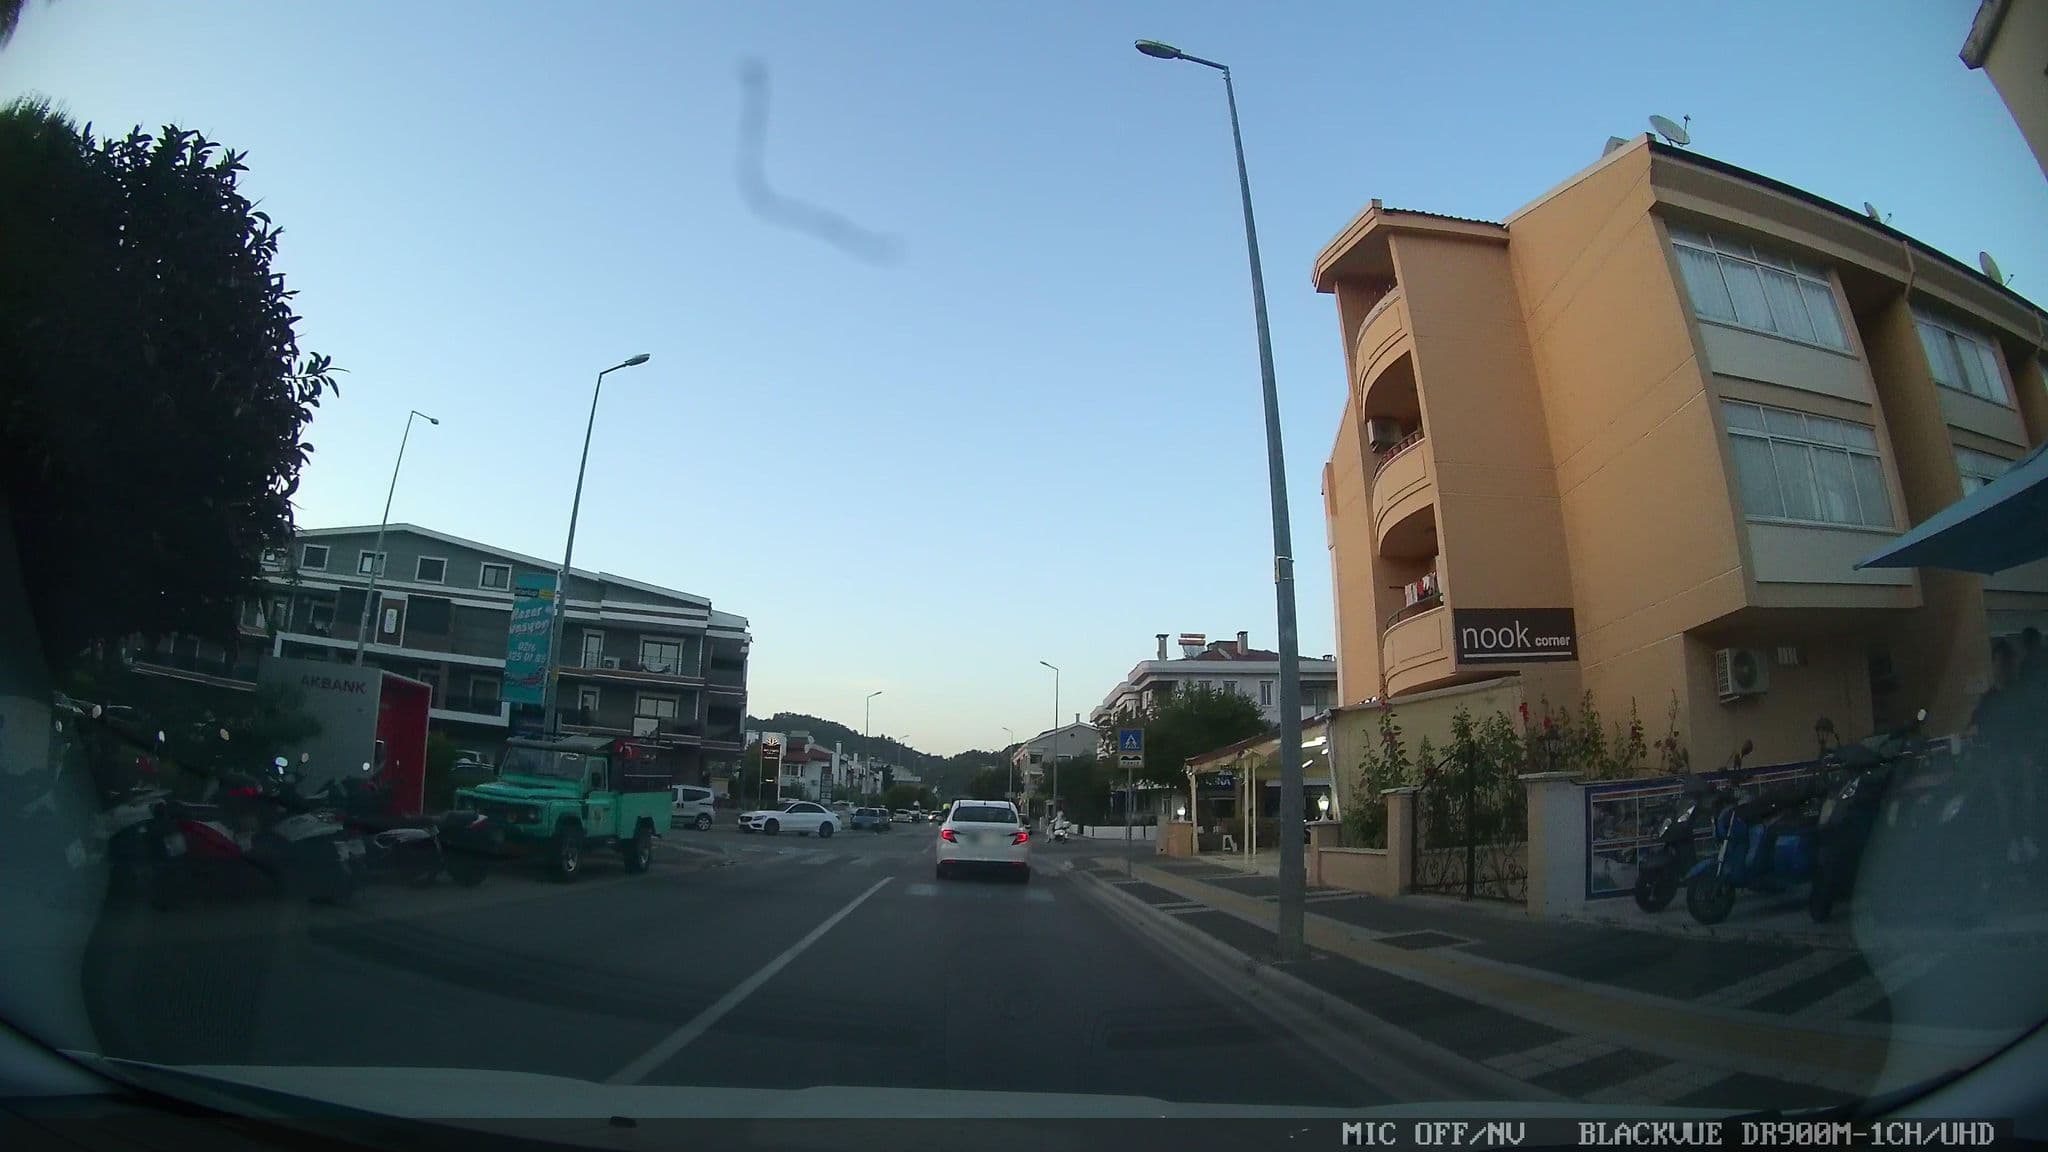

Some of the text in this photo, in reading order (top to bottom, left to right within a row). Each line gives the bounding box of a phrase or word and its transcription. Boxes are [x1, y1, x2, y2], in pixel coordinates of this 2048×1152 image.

[1462, 620, 1570, 649] nook corner
[301, 675, 368, 695] AKBANK
